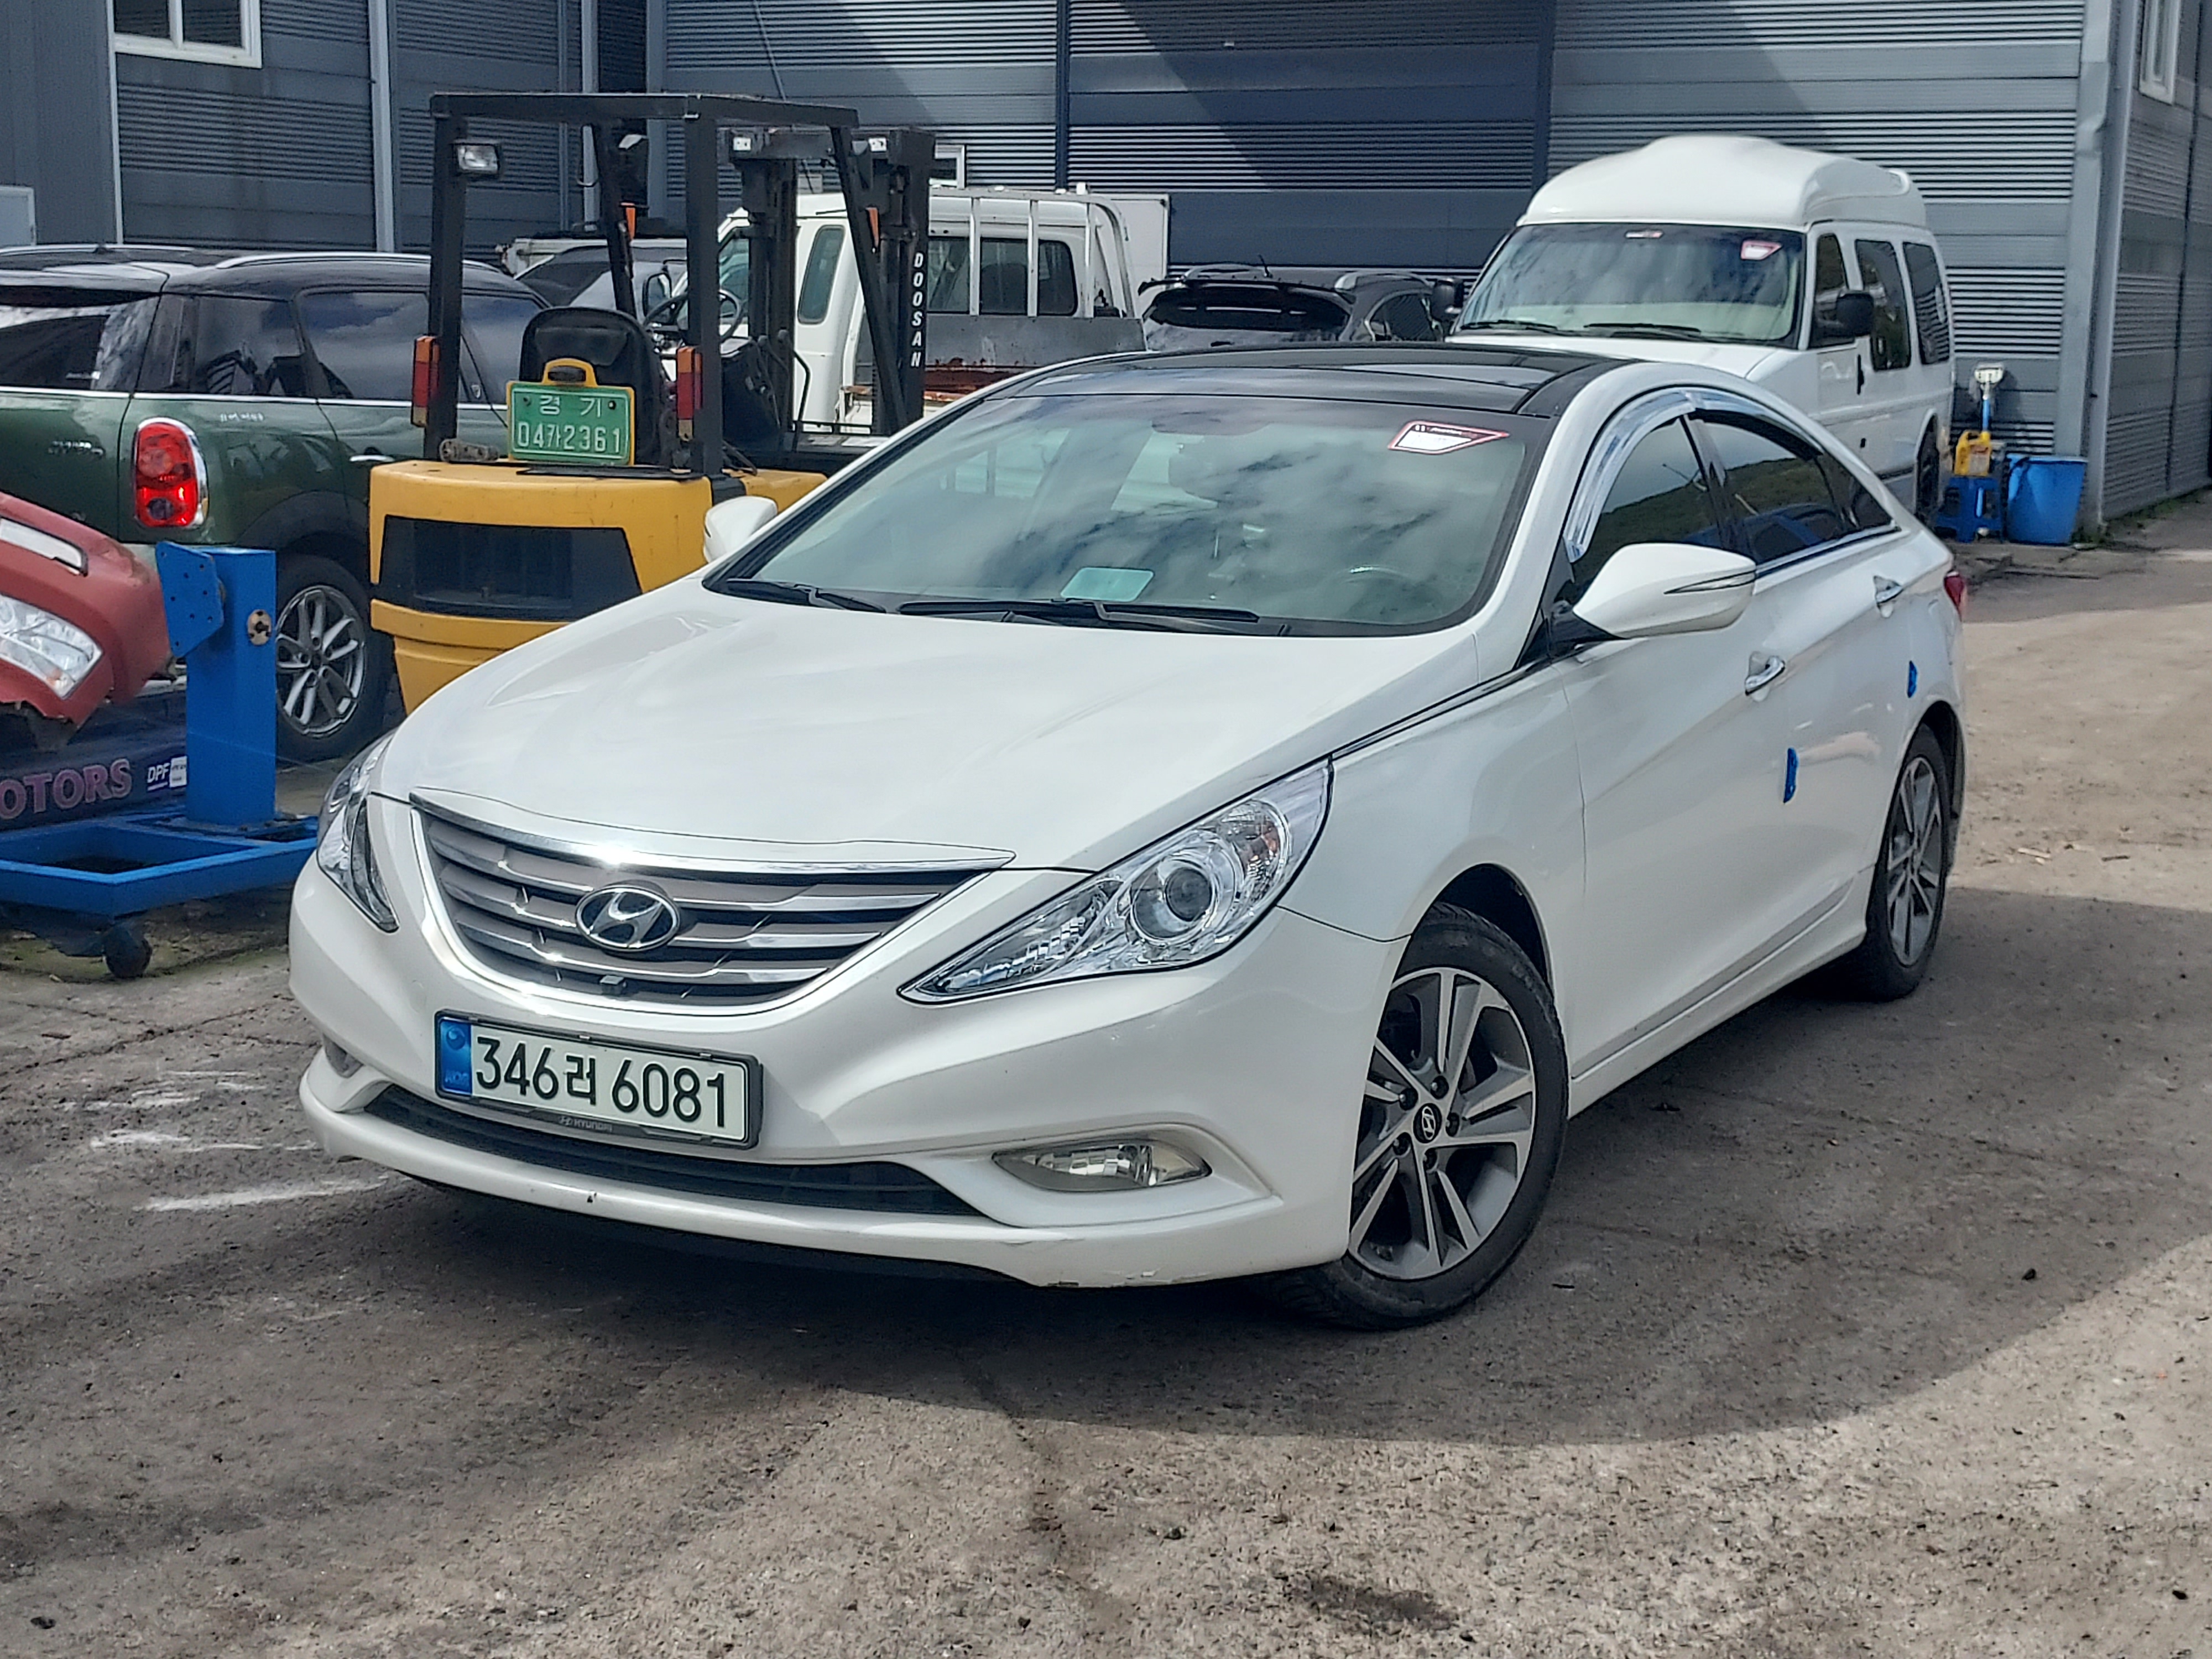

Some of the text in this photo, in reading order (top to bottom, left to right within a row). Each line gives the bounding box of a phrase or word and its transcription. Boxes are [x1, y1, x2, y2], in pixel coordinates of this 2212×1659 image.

[911, 252, 924, 367] DOOSAN
[147, 763, 170, 784] DPF
[612, 1059, 726, 1128] 6081
